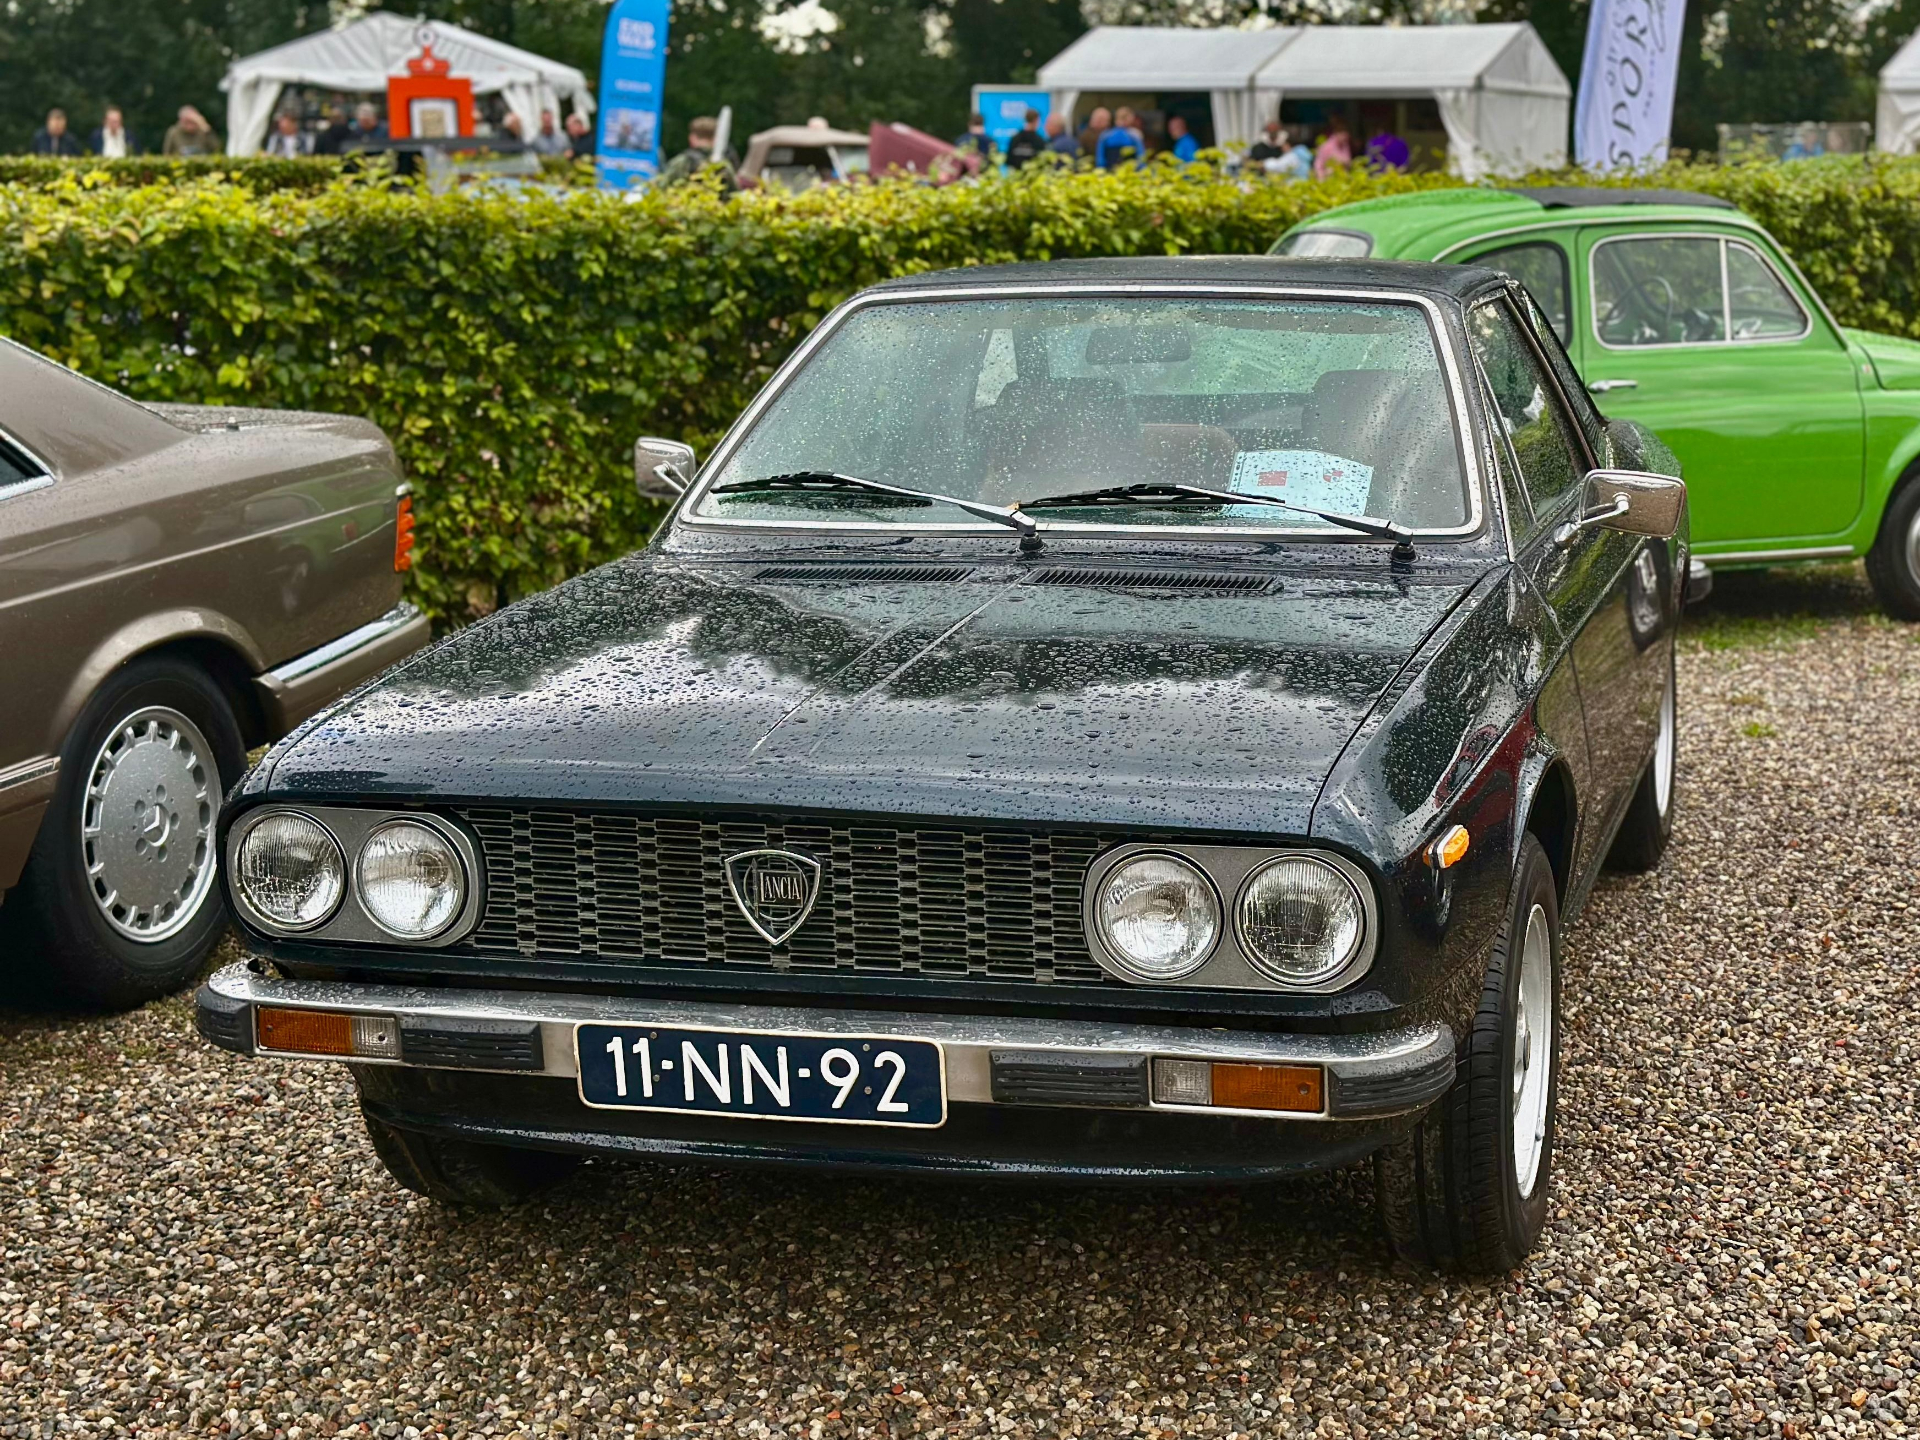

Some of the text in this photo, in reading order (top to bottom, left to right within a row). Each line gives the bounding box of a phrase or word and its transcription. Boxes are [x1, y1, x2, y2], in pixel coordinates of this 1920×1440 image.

[1608, 0, 1650, 168] SPOR
[760, 872, 802, 903] LANCIA
[606, 1036, 909, 1113] 11-NN-92
